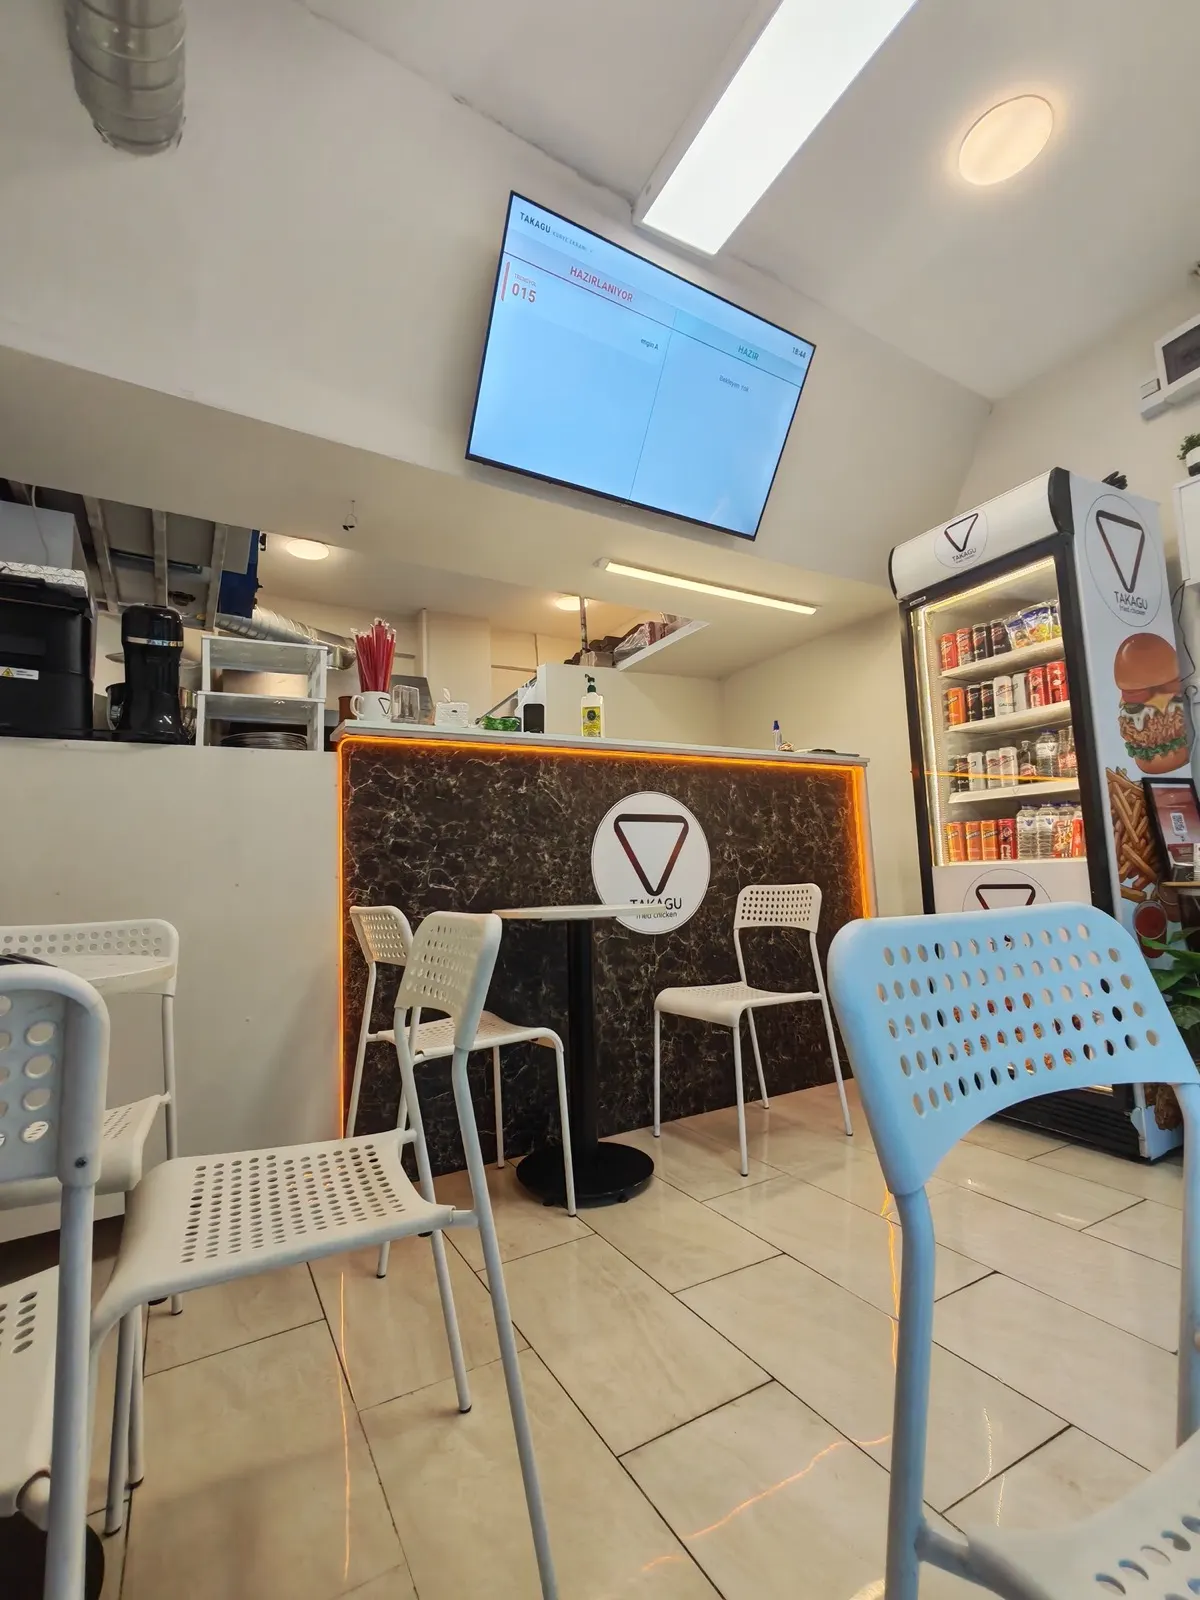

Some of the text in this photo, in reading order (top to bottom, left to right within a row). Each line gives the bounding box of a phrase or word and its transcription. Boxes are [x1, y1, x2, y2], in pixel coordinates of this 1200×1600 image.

[520, 212, 551, 233] TAKAGU
[512, 283, 537, 303] 015
[569, 266, 633, 302] HAZIRLANIYOR
[738, 345, 759, 361] HAZIR
[792, 347, 806, 359] 18:44
[952, 548, 977, 561] TAKAGU
[1114, 591, 1148, 610] TAKAGU
